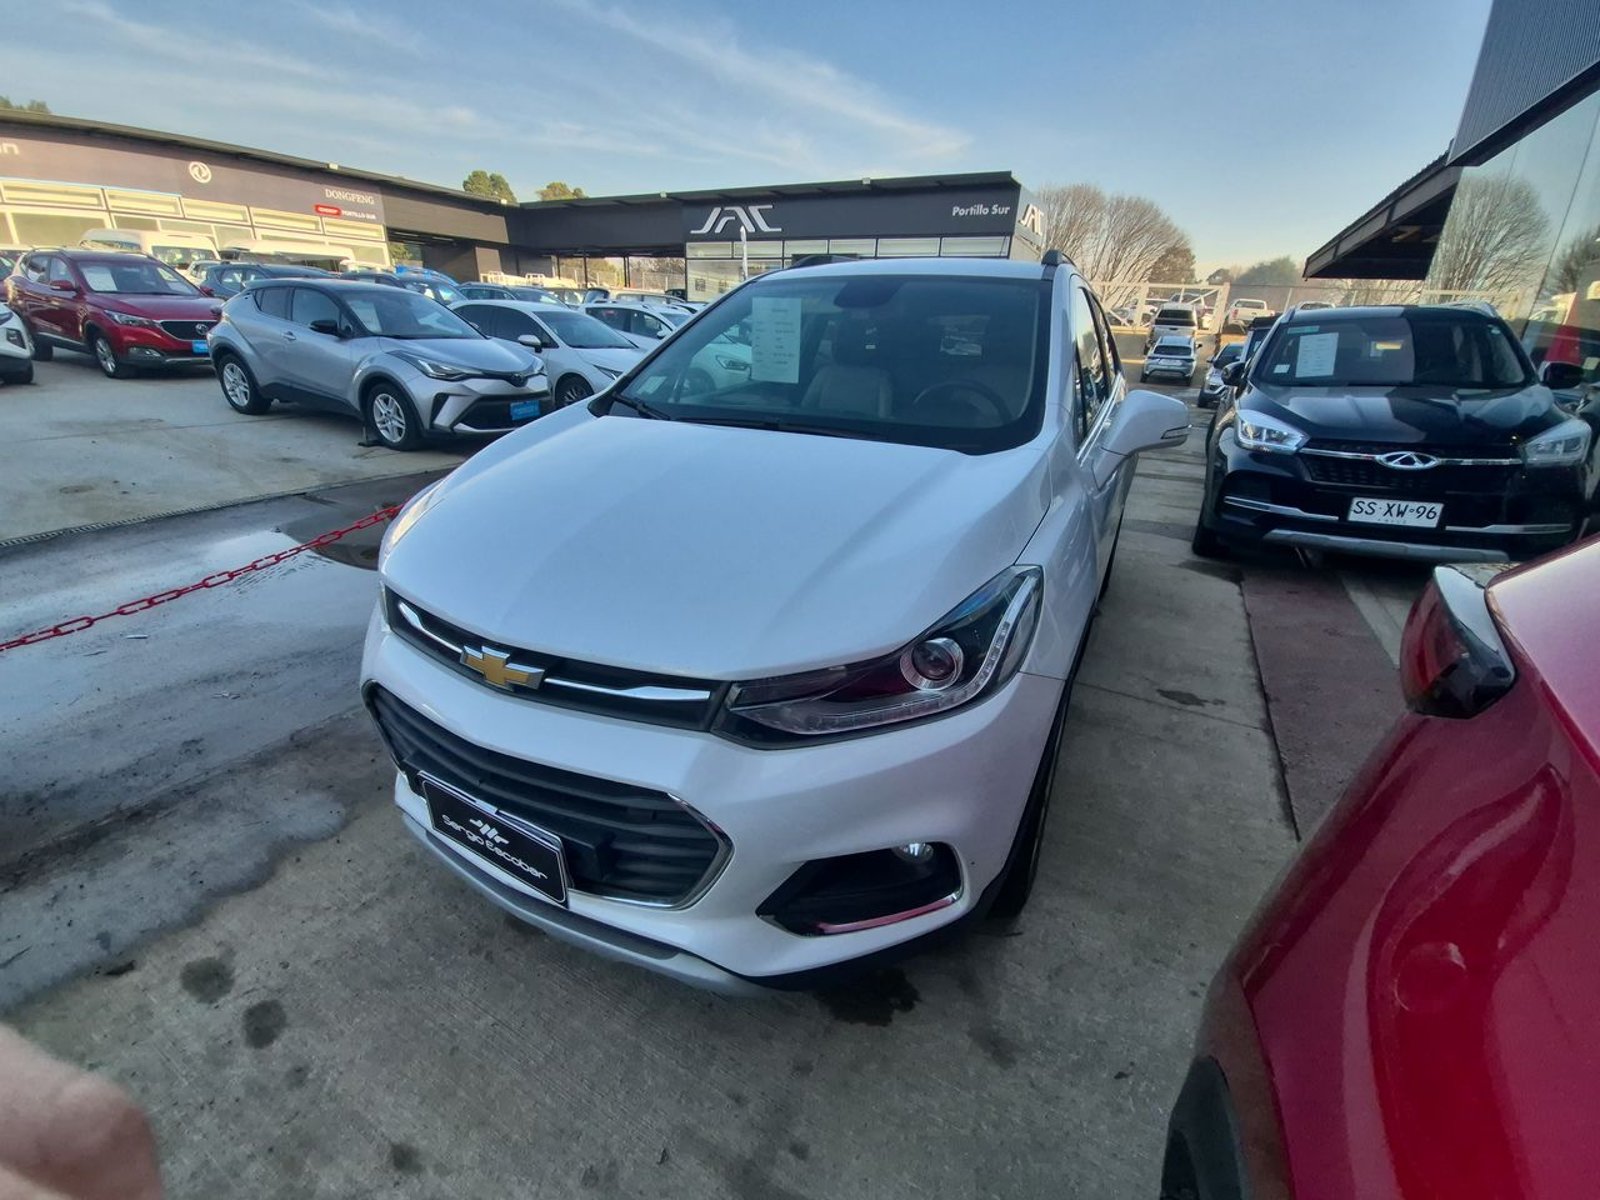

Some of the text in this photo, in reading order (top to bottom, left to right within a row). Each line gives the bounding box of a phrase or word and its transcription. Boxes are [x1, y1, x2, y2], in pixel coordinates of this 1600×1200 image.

[325, 188, 375, 204] DONGFENG
[952, 203, 1010, 216] Portillo Sur
[690, 204, 782, 234] JAC
